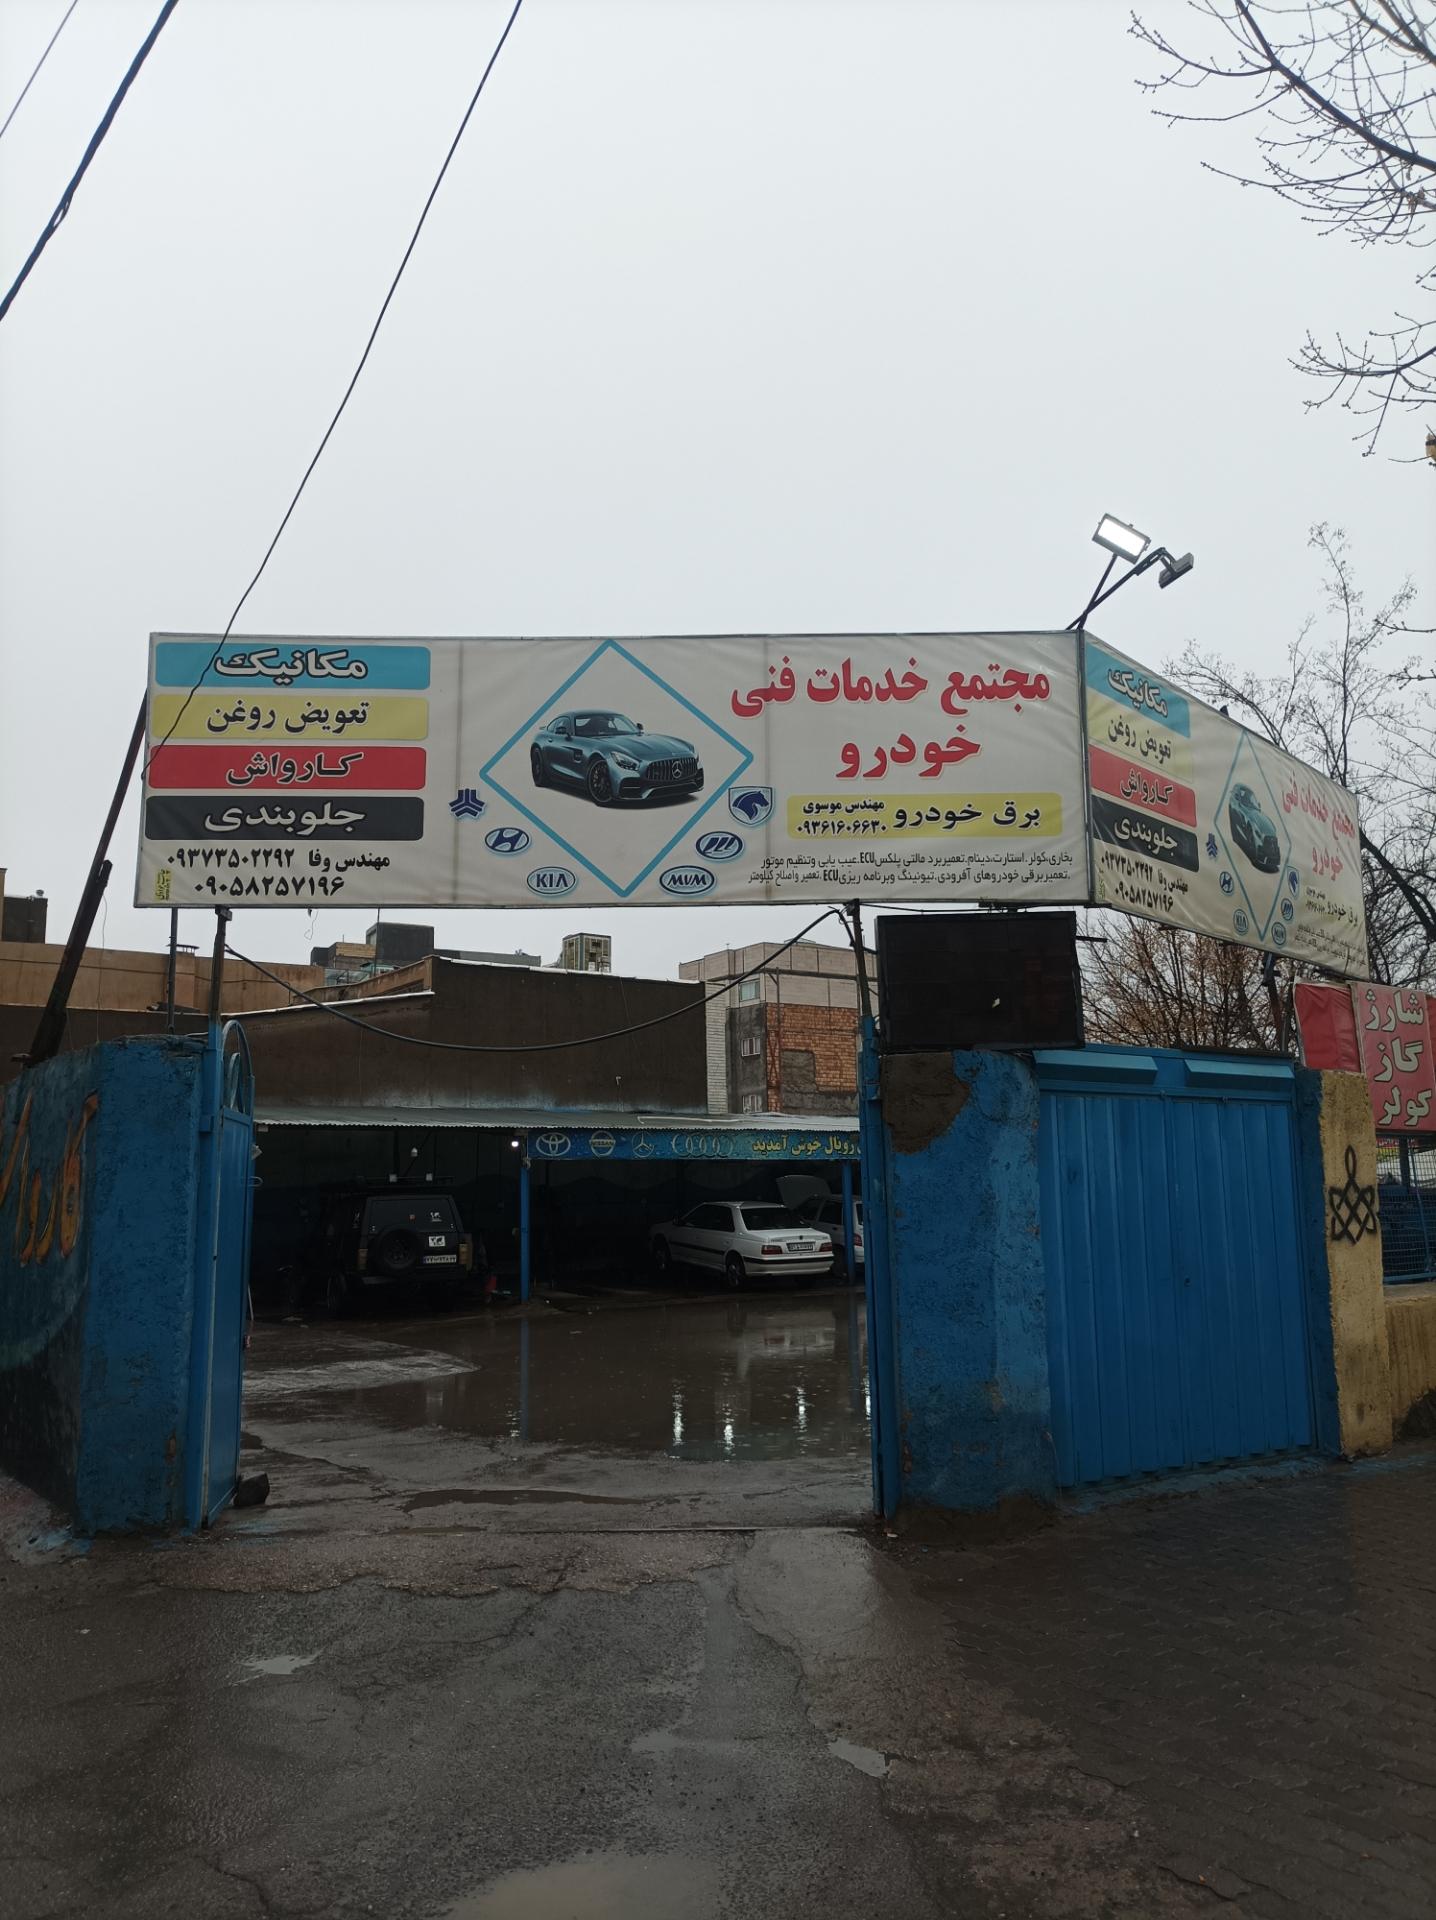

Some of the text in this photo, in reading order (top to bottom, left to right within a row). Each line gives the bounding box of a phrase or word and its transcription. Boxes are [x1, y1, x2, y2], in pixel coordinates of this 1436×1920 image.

[214, 648, 368, 685] مکانیک
[731, 655, 1050, 718] مجتمع خدمات فنی
[207, 700, 369, 734] تعویض روغن
[835, 724, 982, 779] خودرو
[1108, 715, 1171, 764] تعویض روغن
[226, 752, 364, 786] کارواش
[1120, 768, 1173, 805] کارواش
[204, 802, 366, 836] جلوبندی
[802, 799, 884, 814] مهندس موسوی
[893, 801, 1040, 829] برق خودرو
[797, 819, 887, 835] ۰۹۳۶۱۶۰۶۶۳۰
[1114, 818, 1178, 856] جلوبندی
[167, 848, 390, 873] مهندس وفا ۰۹۳۷۳۵۰۲۲۹۲
[761, 857, 784, 869] موتور
[818, 855, 836, 868] یابی
[194, 875, 346, 897] ۰۹۰۵۸۲۵۷۱۹۶
[536, 873, 568, 888] KIA
[667, 873, 707, 887] MVM
[748, 870, 774, 884] کیلومتر
[974, 869, 1019, 883] خودروهای
[1365, 989, 1424, 1032] شارژ
[1374, 1038, 1424, 1082] گاز
[1378, 1085, 1433, 1126] کولر
[752, 1135, 788, 1156] آمدید
[791, 1136, 821, 1155] خوش
